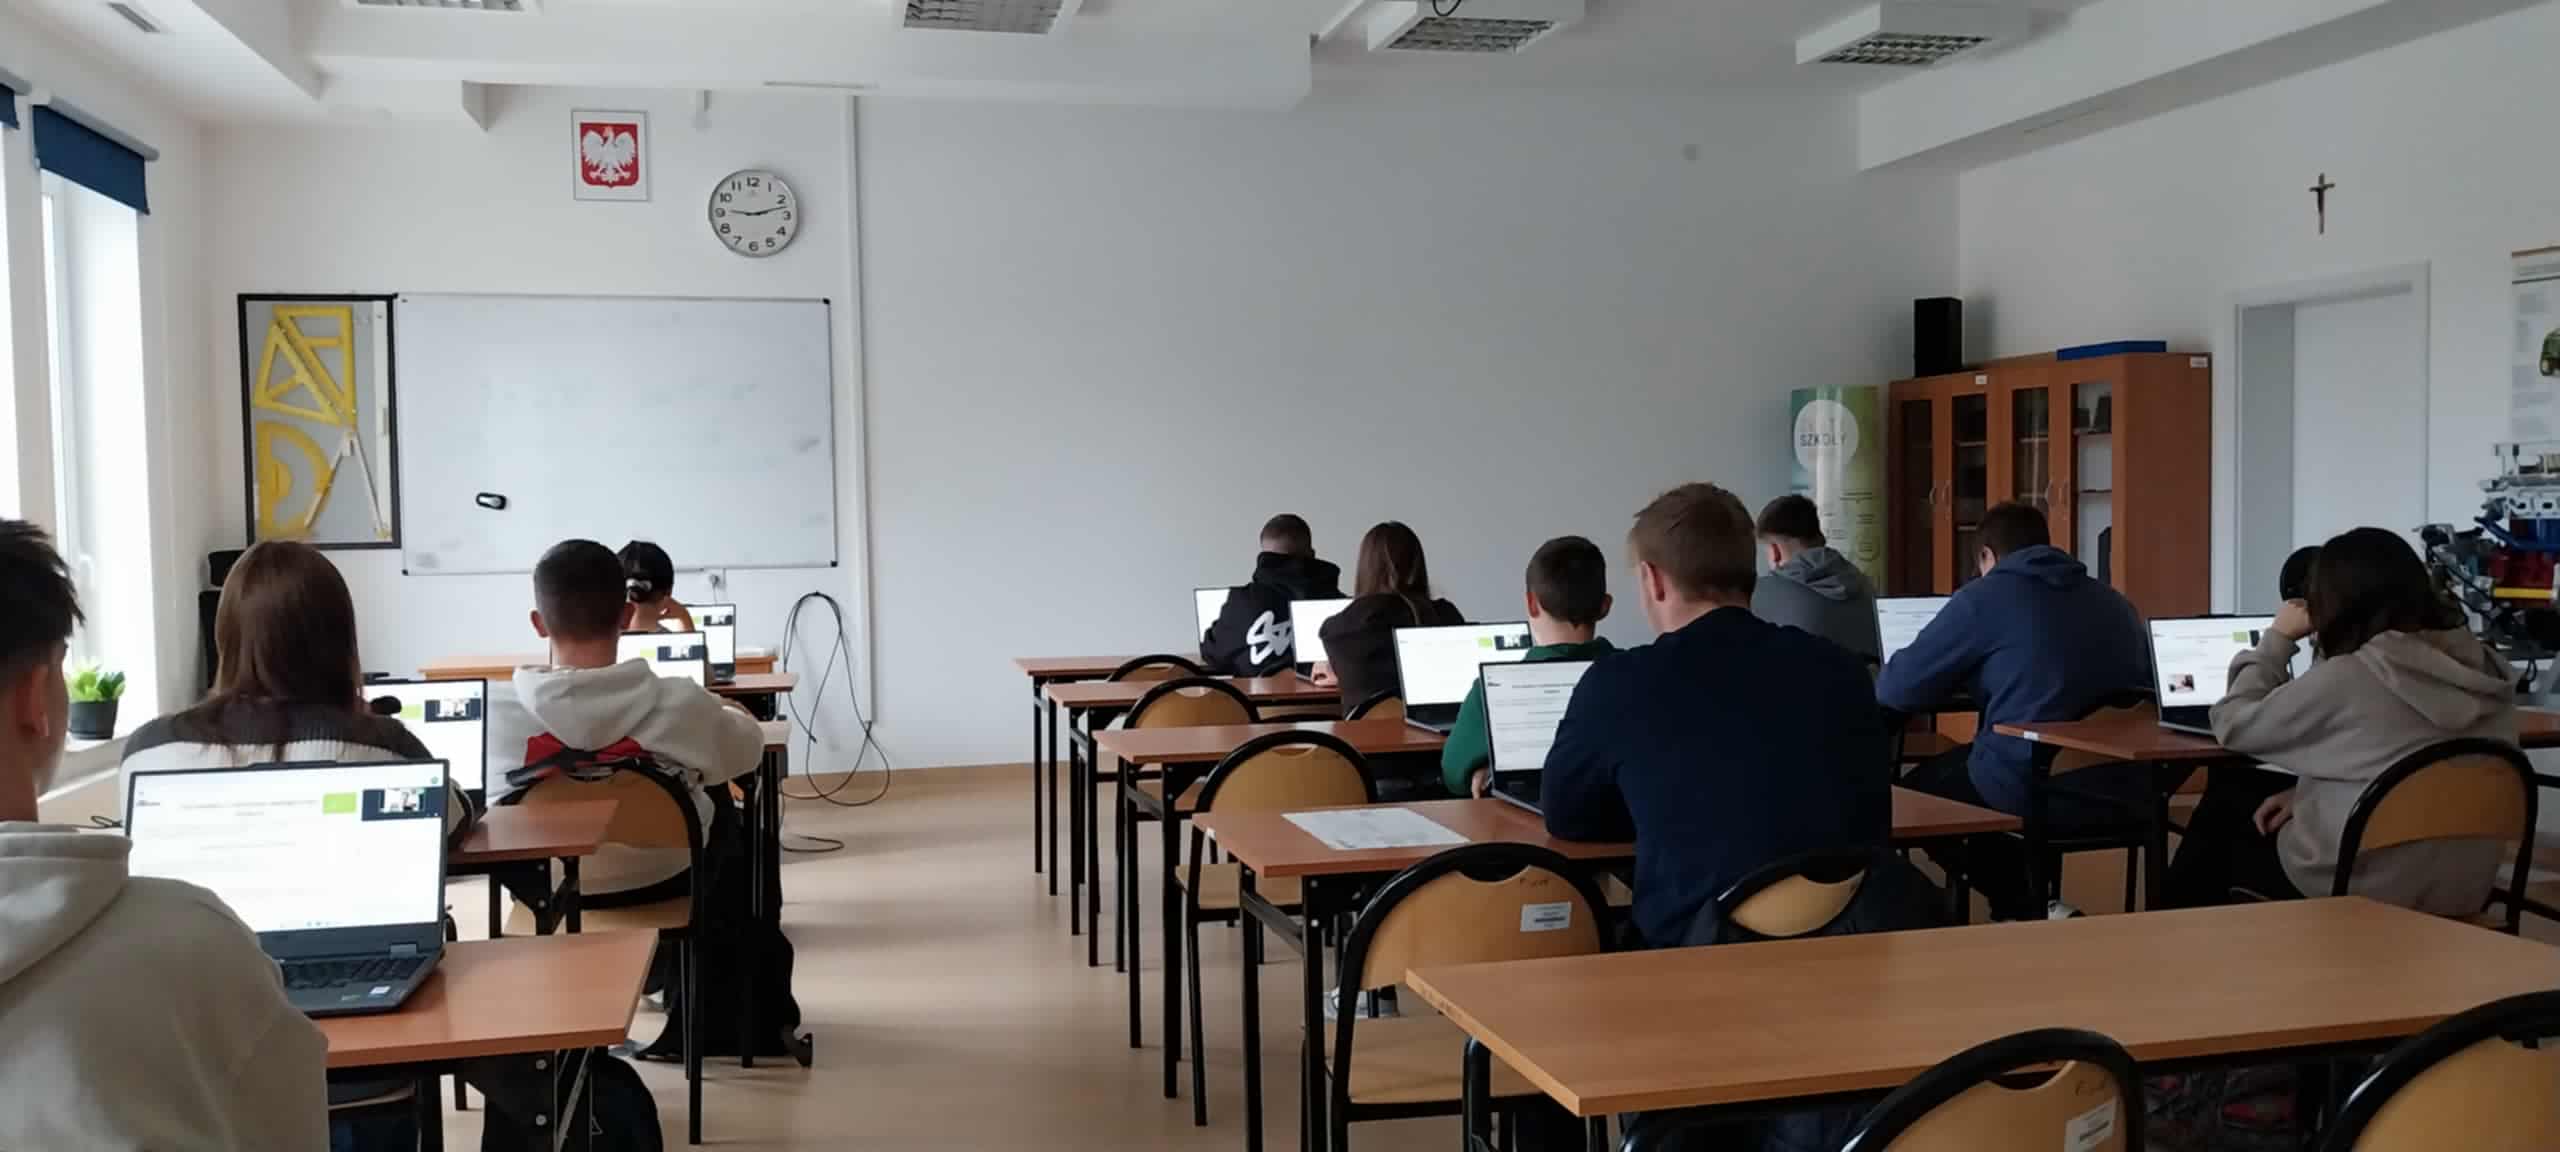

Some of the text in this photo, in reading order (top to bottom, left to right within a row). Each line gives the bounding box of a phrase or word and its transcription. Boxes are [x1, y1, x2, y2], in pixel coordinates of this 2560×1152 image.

[731, 181, 742, 191] 11
[746, 176, 760, 187] 12
[768, 182, 772, 192] 1
[720, 191, 732, 203] 10
[776, 194, 786, 204] 2
[715, 207, 726, 217] 9
[783, 210, 791, 220] 3
[720, 223, 731, 234] 8
[776, 226, 786, 236] 4
[734, 235, 743, 245] 7
[765, 237, 775, 248] 5
[748, 241, 759, 251] 6
